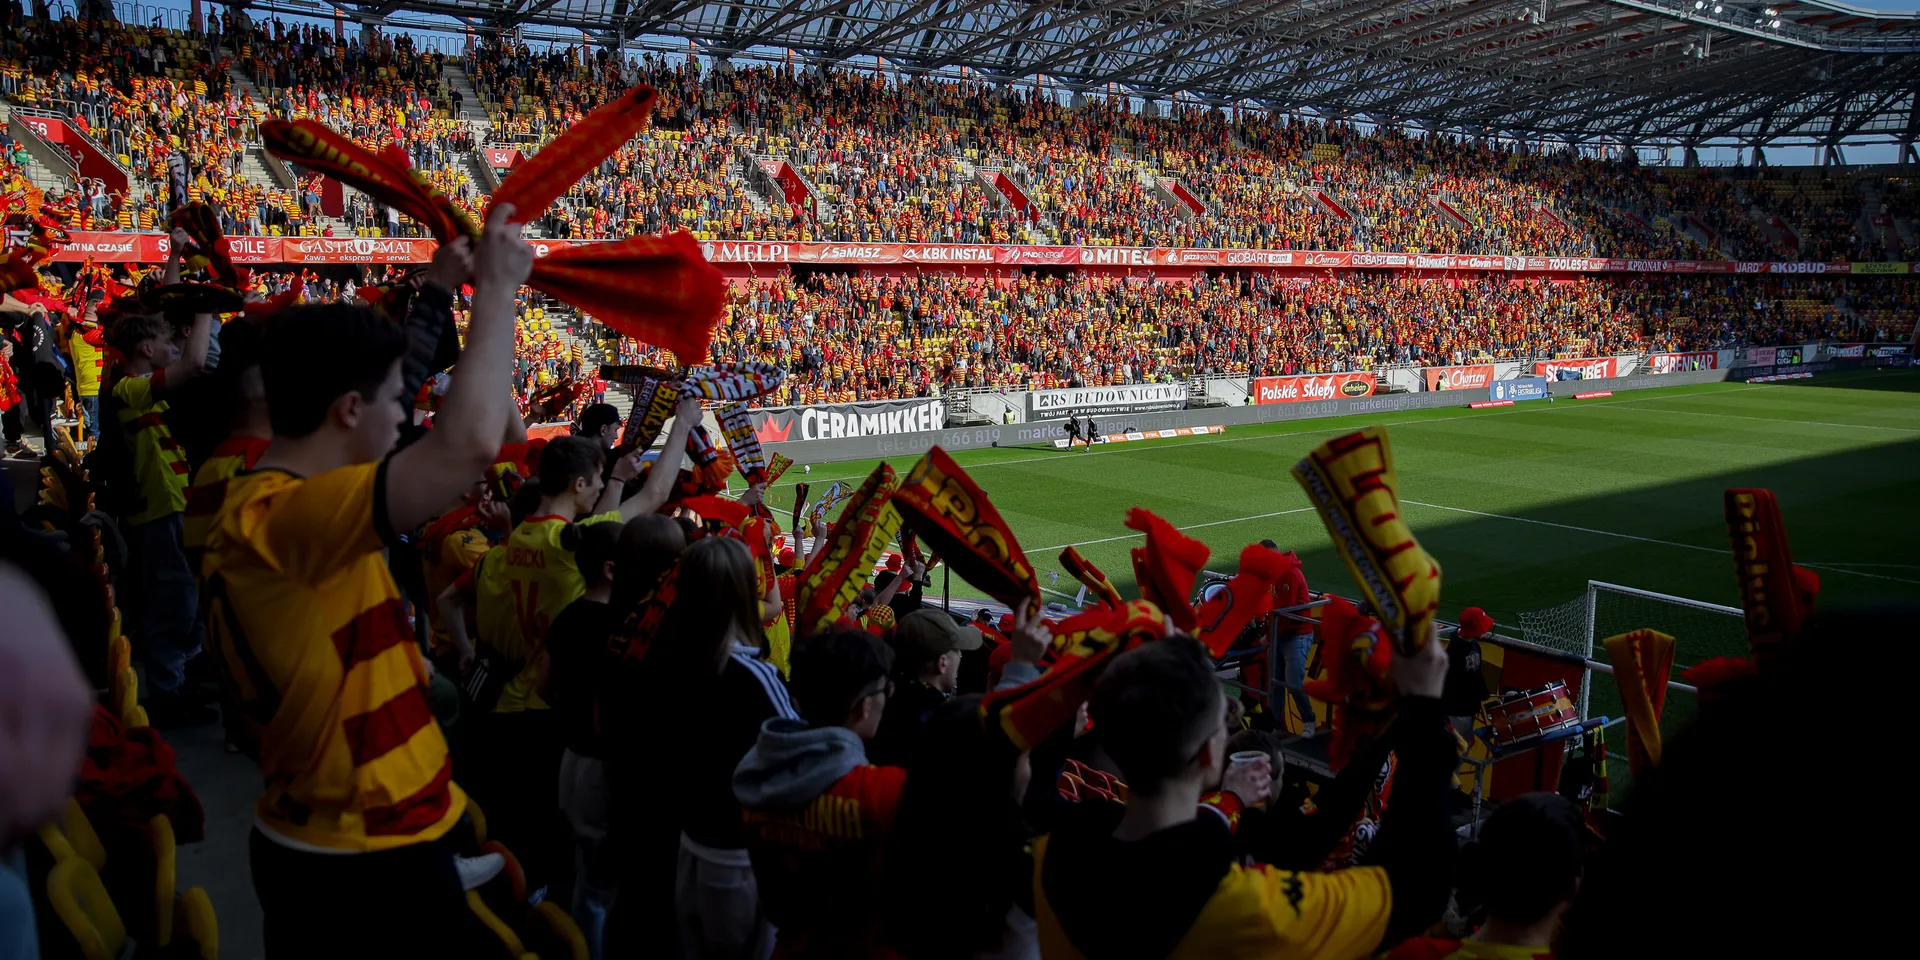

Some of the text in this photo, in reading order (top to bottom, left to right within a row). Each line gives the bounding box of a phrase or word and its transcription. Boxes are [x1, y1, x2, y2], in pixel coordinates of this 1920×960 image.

[494, 152, 509, 164] 54
[765, 164, 777, 174] 53
[82, 243, 95, 252] NA
[97, 243, 133, 252] CZASIE
[720, 242, 790, 262] MELPI
[831, 247, 882, 258] SaMASZ
[922, 247, 994, 260] KBK INSTAL
[339, 254, 374, 262] ekspresy
[1096, 249, 1155, 265] MITEL
[1228, 253, 1268, 264] GLOBART
[1352, 256, 1387, 265] GLOBART
[1670, 354, 1713, 373] BENIAR
[1451, 369, 1487, 387] Chorten
[1261, 382, 1336, 400] Polskie Sklepy
[801, 400, 944, 441] CERAMIKKER
[941, 432, 971, 447] 666
[975, 428, 1000, 444] 819
